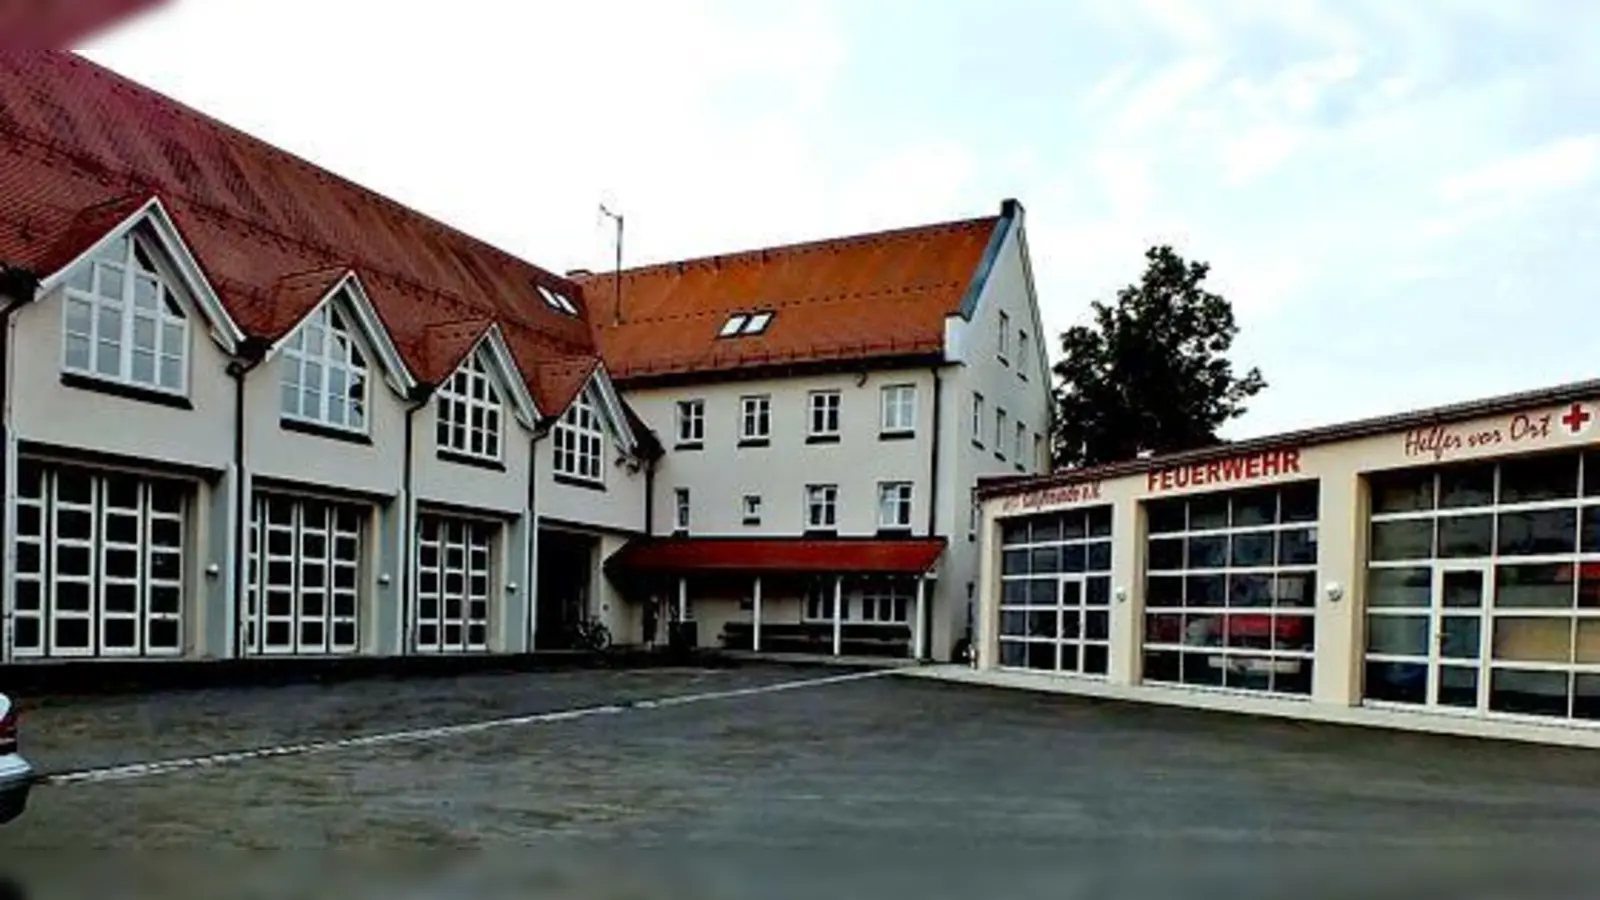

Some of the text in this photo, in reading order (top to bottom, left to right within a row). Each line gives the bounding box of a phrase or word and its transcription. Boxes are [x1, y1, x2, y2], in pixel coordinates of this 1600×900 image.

[1405, 414, 1550, 460] Helfer vor Ort
[1147, 450, 1300, 491] FEUERWEHR
